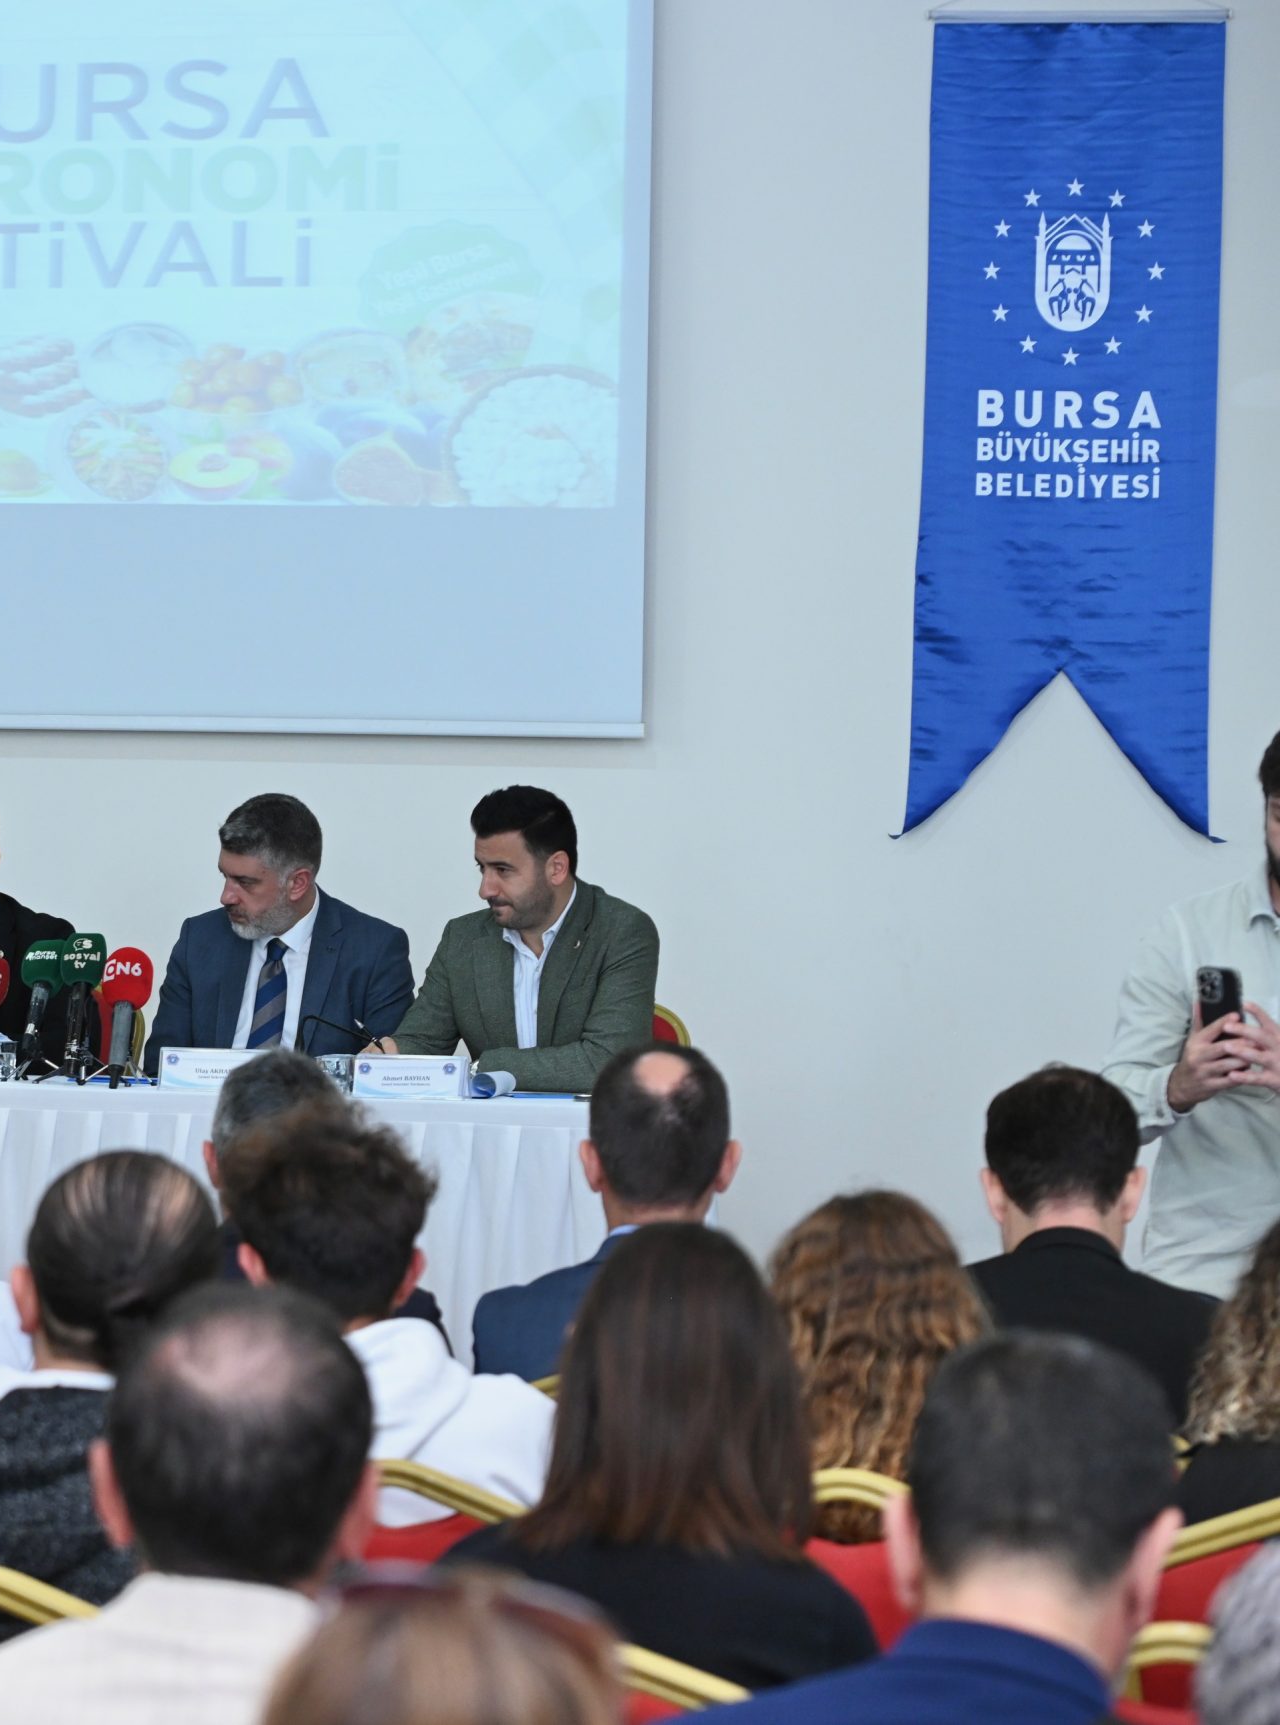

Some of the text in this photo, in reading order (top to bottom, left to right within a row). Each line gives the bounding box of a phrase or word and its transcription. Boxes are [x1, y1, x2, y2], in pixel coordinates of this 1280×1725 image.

[977, 389, 1162, 429] BURSA
[976, 430, 1161, 469] BÜYÜKŞEHİR
[975, 465, 1161, 499] BELEDİYESİ
